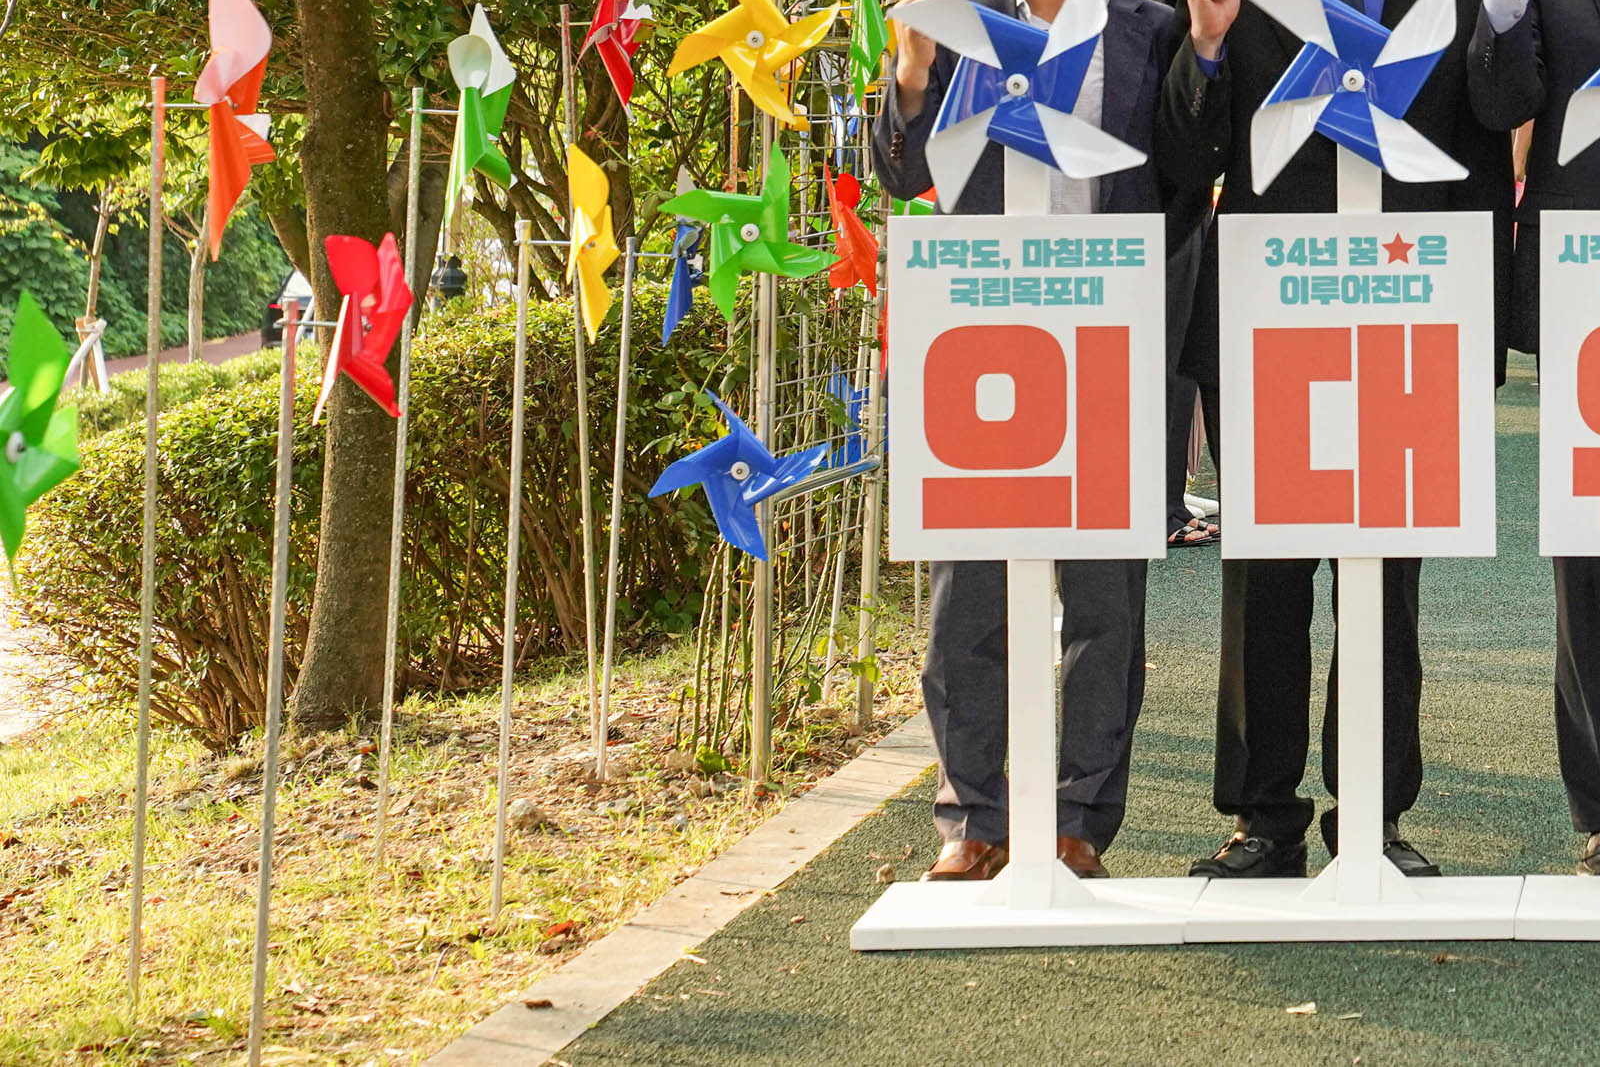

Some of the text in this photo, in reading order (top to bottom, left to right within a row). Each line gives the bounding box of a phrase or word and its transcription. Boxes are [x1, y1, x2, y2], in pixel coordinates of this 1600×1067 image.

[906, 237, 1146, 271] 시작도, 마침표도
[1265, 236, 1338, 267] 34년
[949, 276, 1105, 307] 국립목포대
[1279, 274, 1433, 306] 이루어진다
[922, 324, 1131, 530] 의
[1253, 323, 1461, 528] 대
